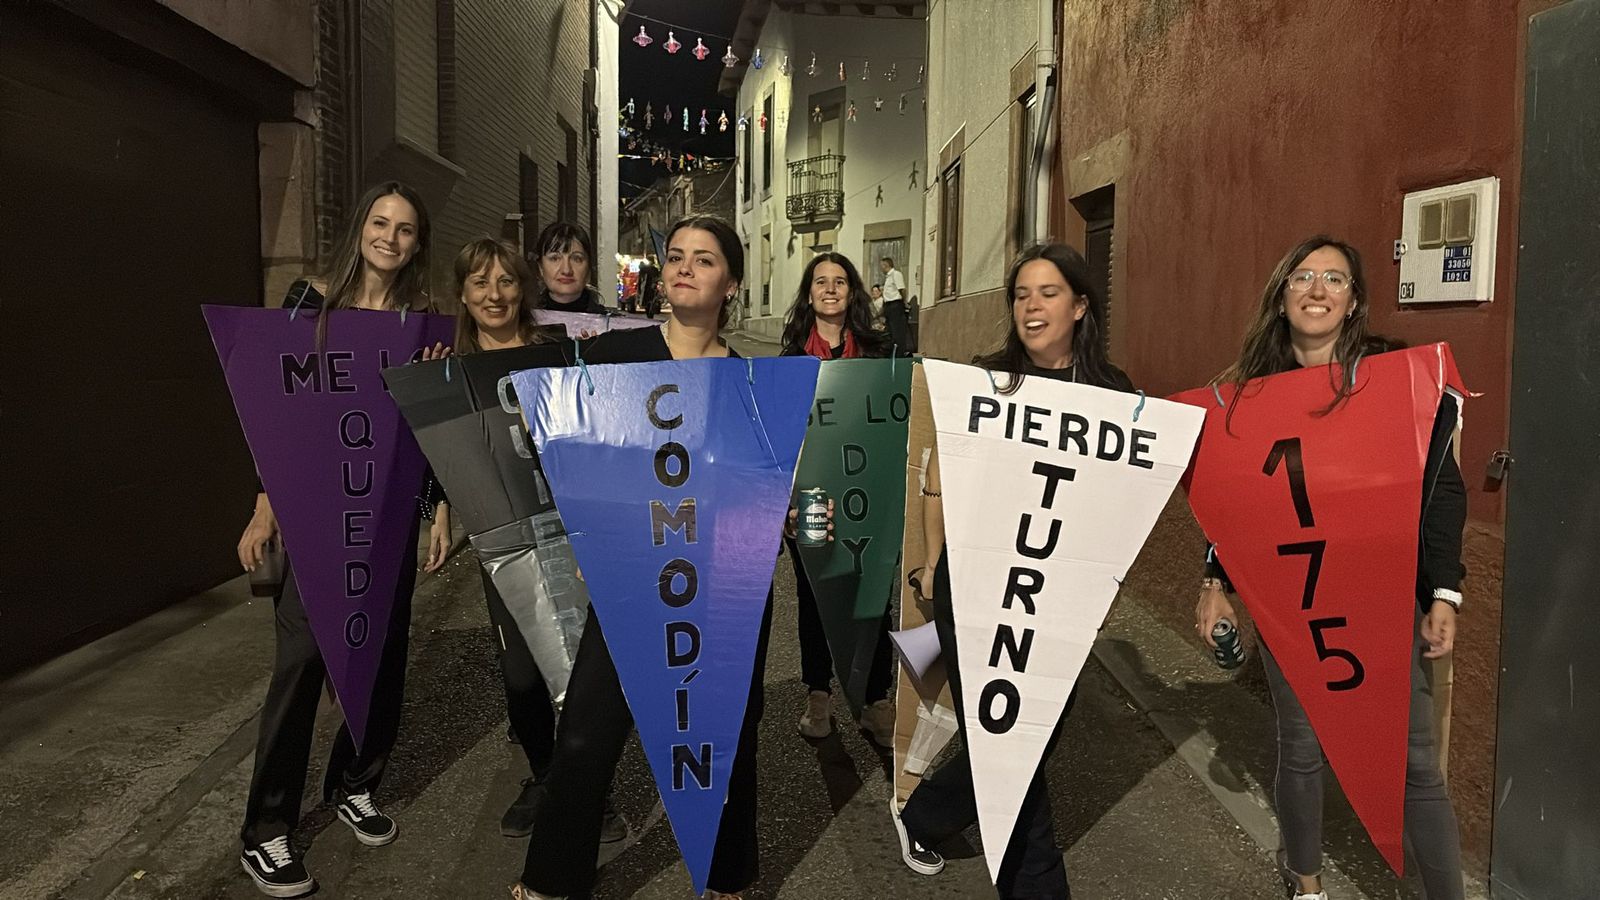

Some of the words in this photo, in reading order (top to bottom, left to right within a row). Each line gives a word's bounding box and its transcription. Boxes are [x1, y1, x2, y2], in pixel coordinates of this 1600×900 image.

[1401, 284, 1413, 298] 01
[280, 351, 357, 396] ME
[807, 397, 838, 427] E
[865, 392, 909, 424] LO
[968, 395, 1157, 470] PIERDE
[338, 409, 376, 650] QUEDO
[840, 442, 873, 575] DOY
[1262, 437, 1366, 692] 175
[646, 383, 714, 792] COMODÍN
[978, 461, 1077, 735] TURNO
